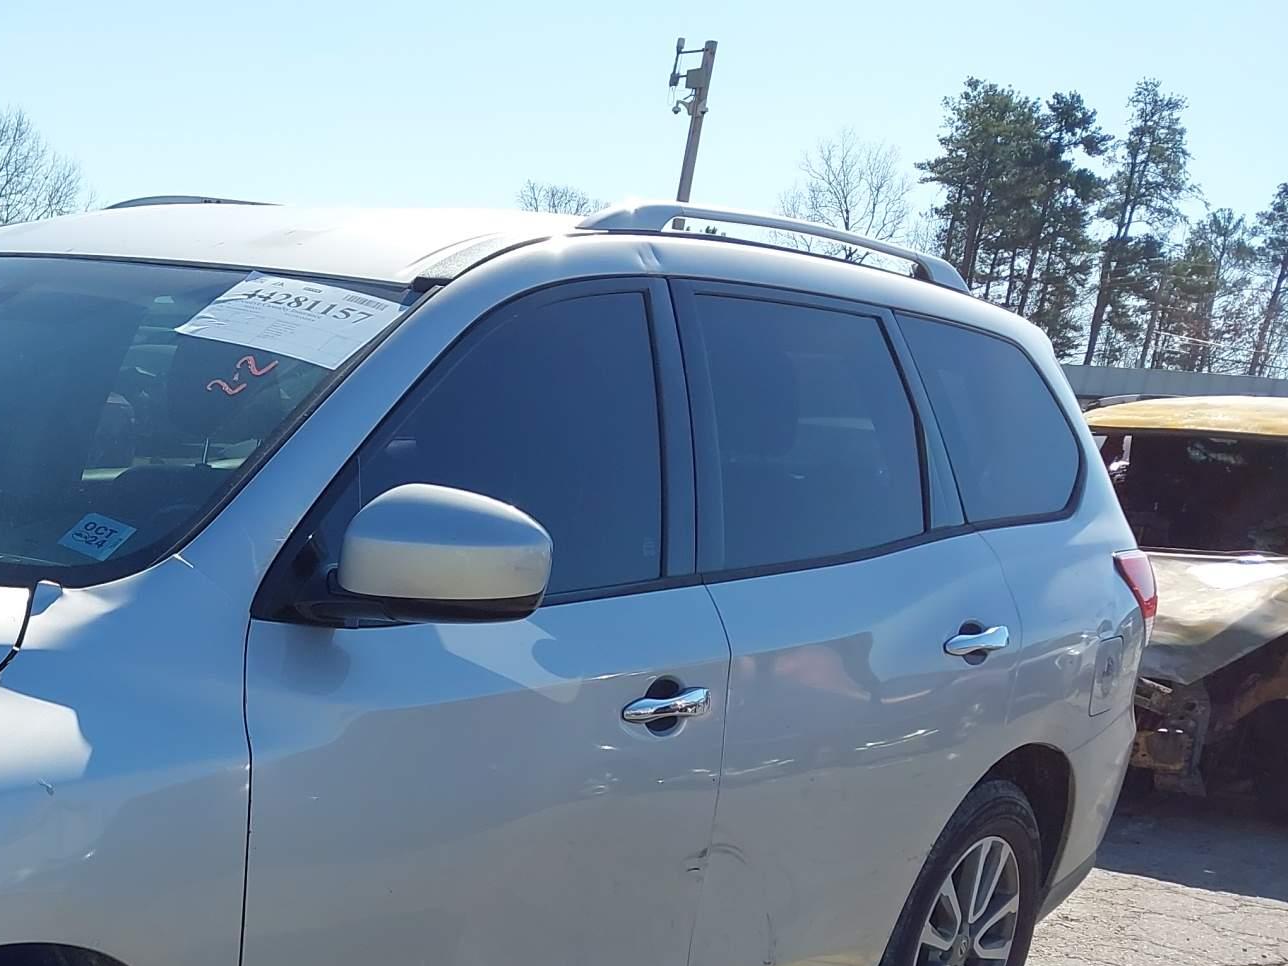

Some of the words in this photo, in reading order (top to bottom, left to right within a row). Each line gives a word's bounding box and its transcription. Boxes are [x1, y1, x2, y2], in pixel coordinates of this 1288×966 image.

[242, 288, 374, 324] 44281157
[84, 521, 118, 539] OCT
[85, 535, 106, 549] 24
